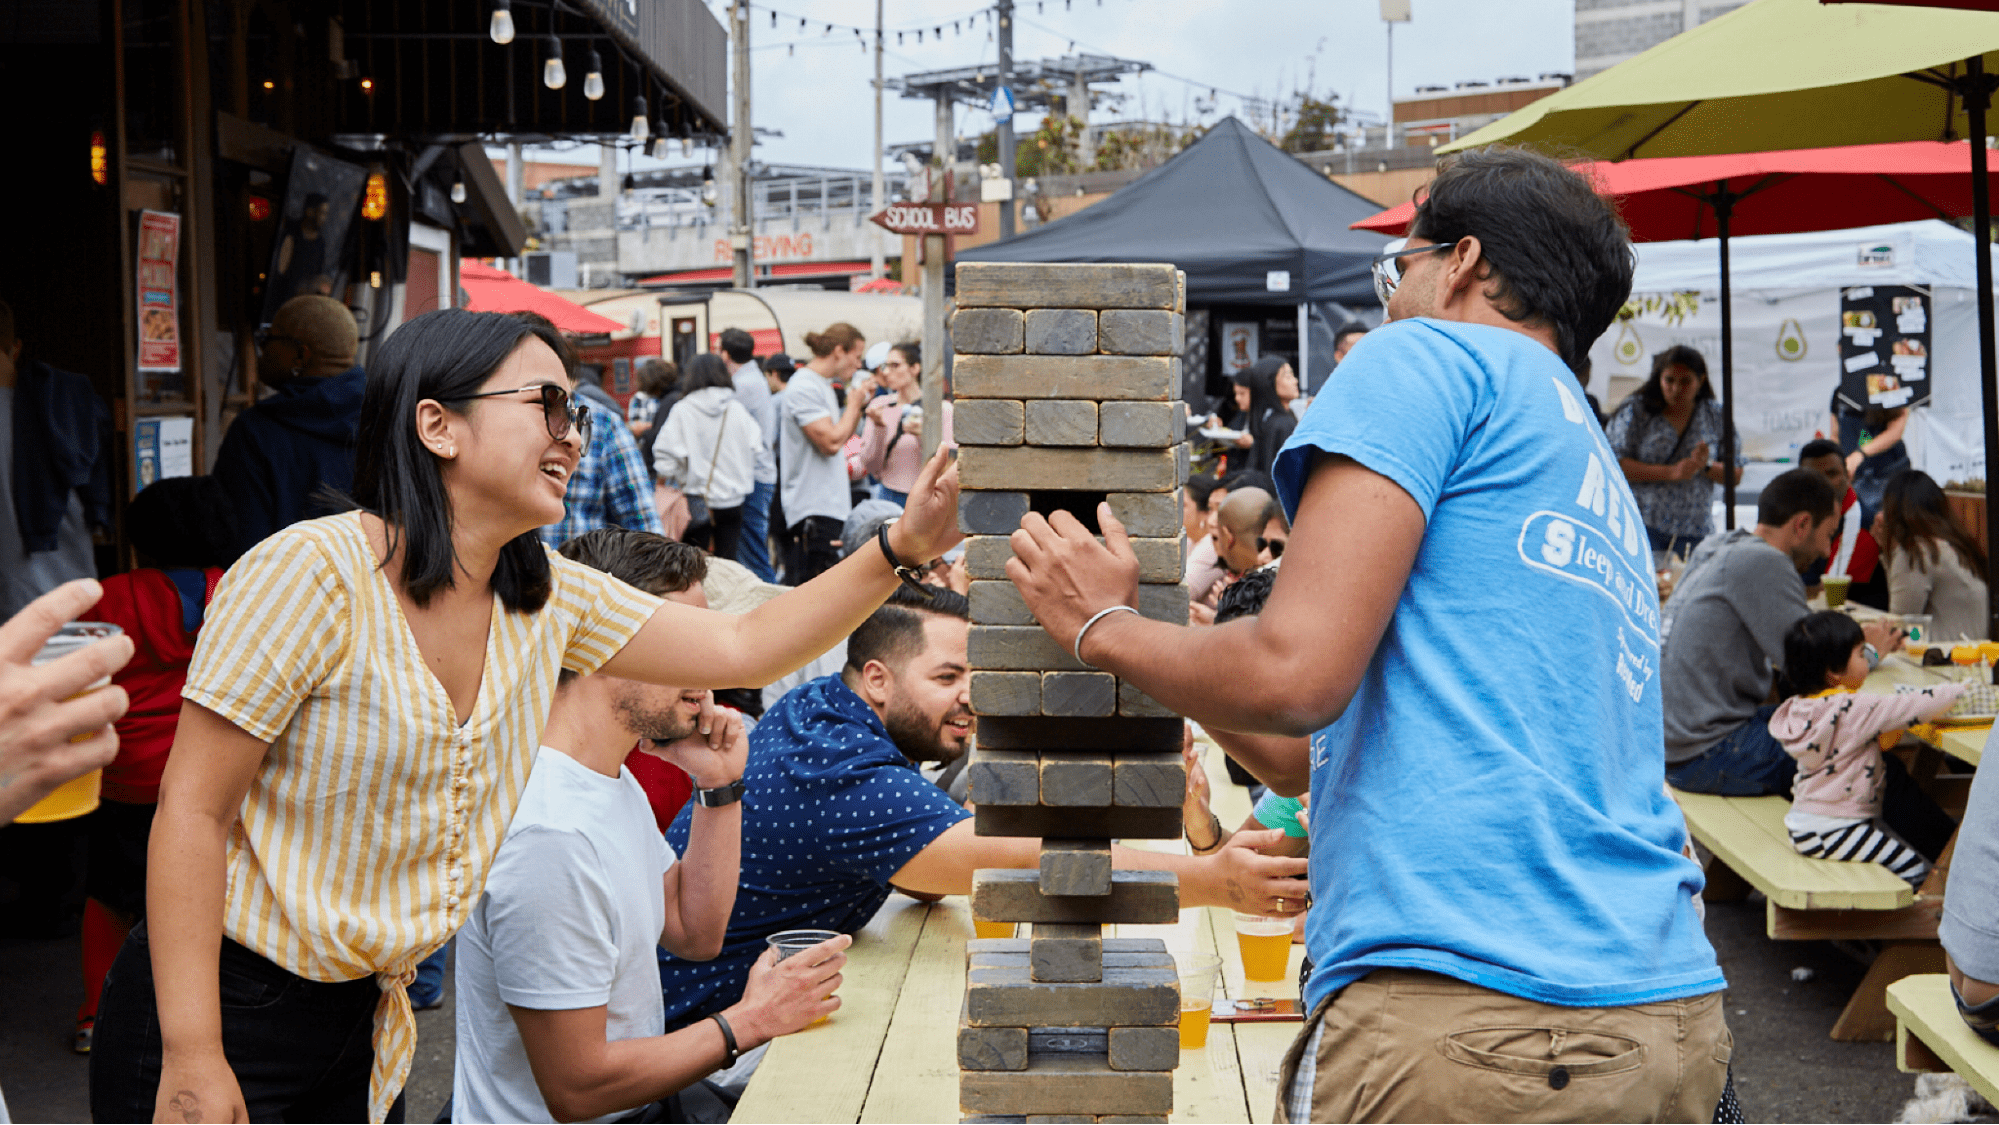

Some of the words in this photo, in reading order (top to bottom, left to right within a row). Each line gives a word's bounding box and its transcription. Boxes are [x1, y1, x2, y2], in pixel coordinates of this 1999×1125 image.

[885, 206, 938, 229] SCHOOL
[945, 206, 976, 229] BUS
[714, 232, 813, 262] REEIVING
[1634, 589, 1659, 631] Dre
